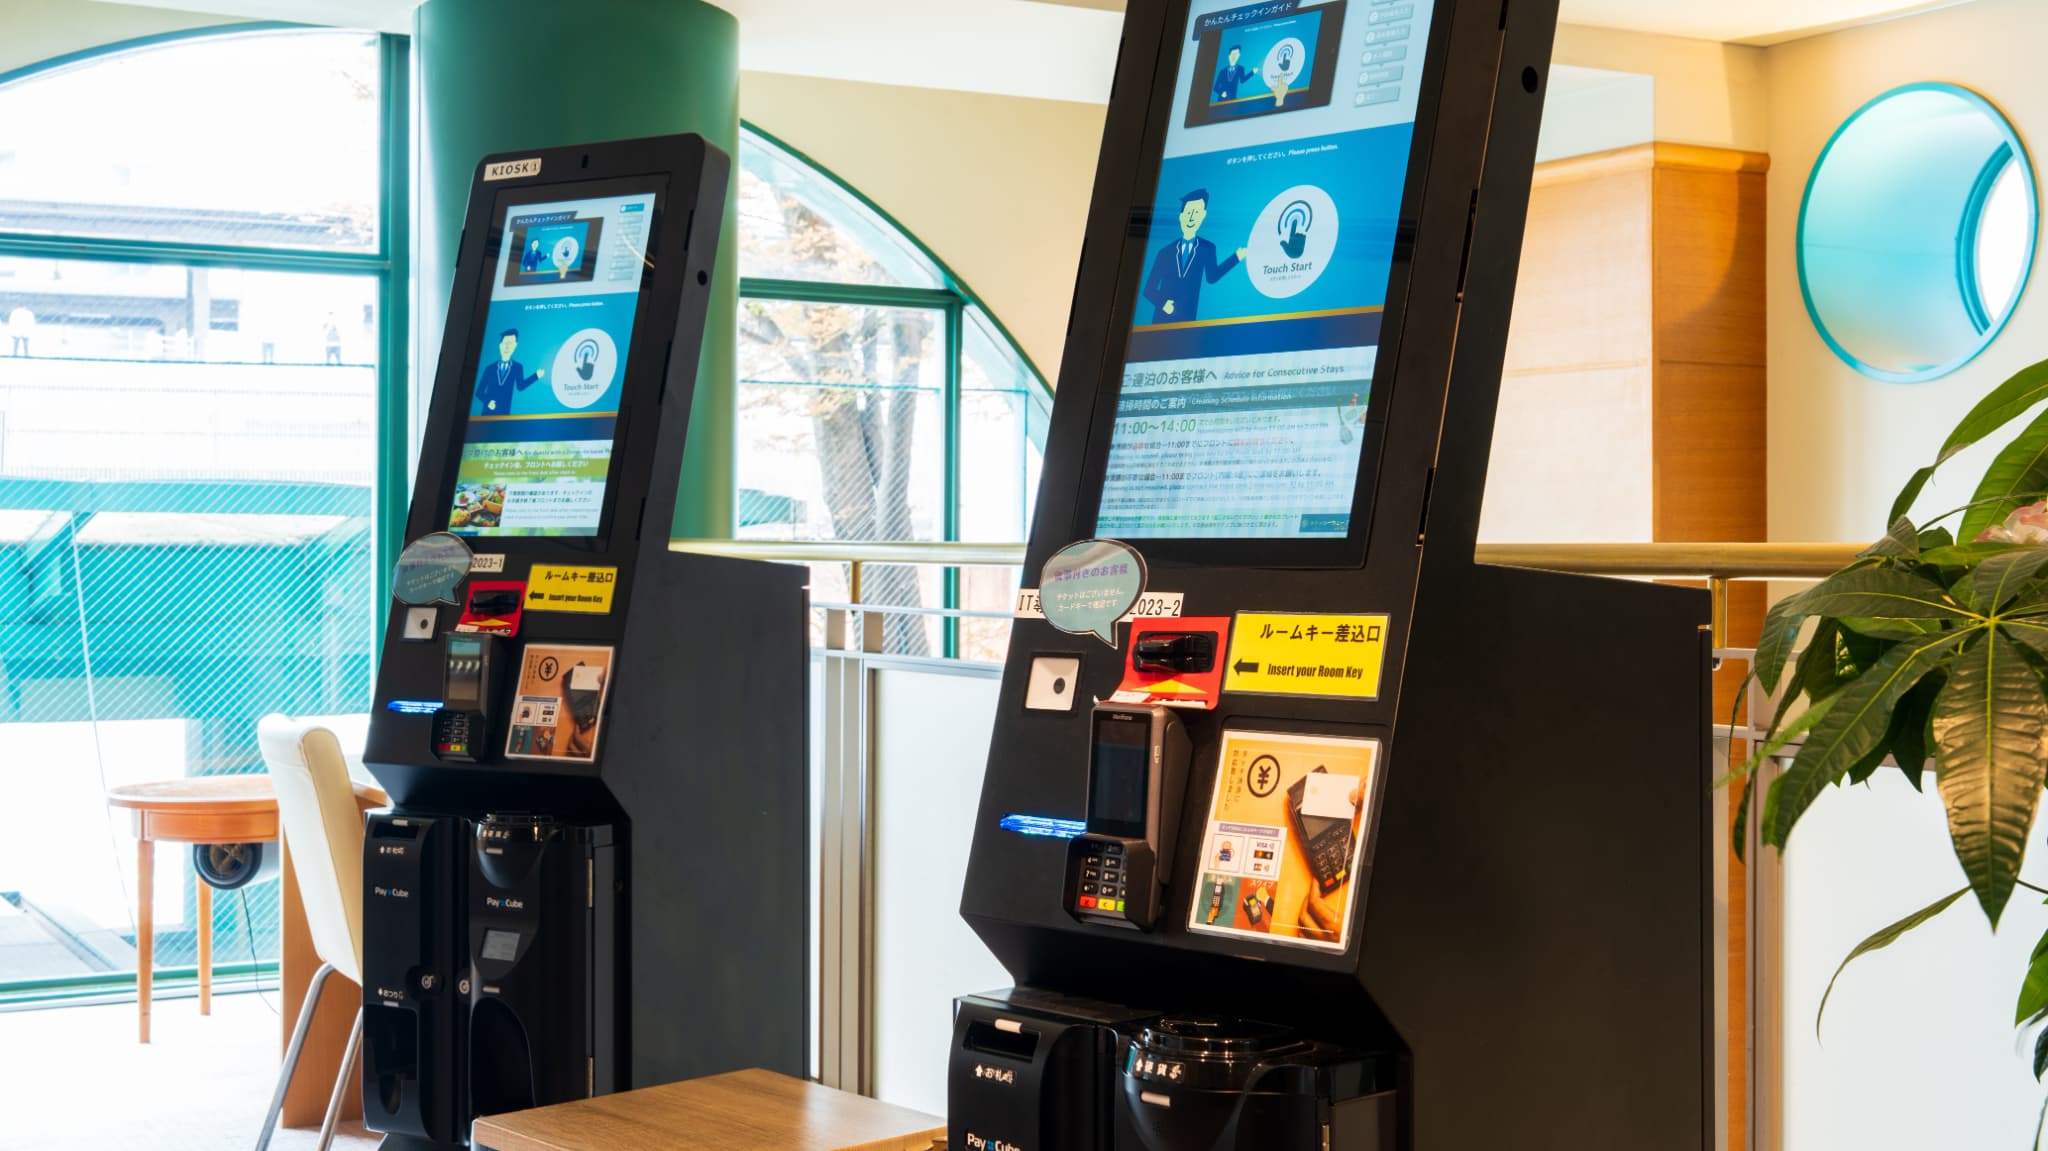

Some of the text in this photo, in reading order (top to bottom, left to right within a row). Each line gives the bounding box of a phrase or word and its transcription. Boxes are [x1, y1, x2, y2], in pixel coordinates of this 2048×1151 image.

[1203, 2, 1293, 27] かんたんチェックインガイド
[1263, 261, 1312, 275] Touch Start
[1224, 371, 1250, 380] Advice
[1252, 369, 1265, 379] for
[1267, 366, 1318, 378] Consecutive
[1320, 364, 1345, 375] Stays
[472, 558, 503, 569] 2023-1
[1129, 598, 1181, 617] 023-2
[1260, 623, 1381, 643] ルームキー差込口
[1267, 663, 1363, 680] Insert your Room Key
[375, 886, 409, 898] Pay Cube
[486, 897, 524, 909] Pay Cube
[967, 1133, 986, 1151] Pay
